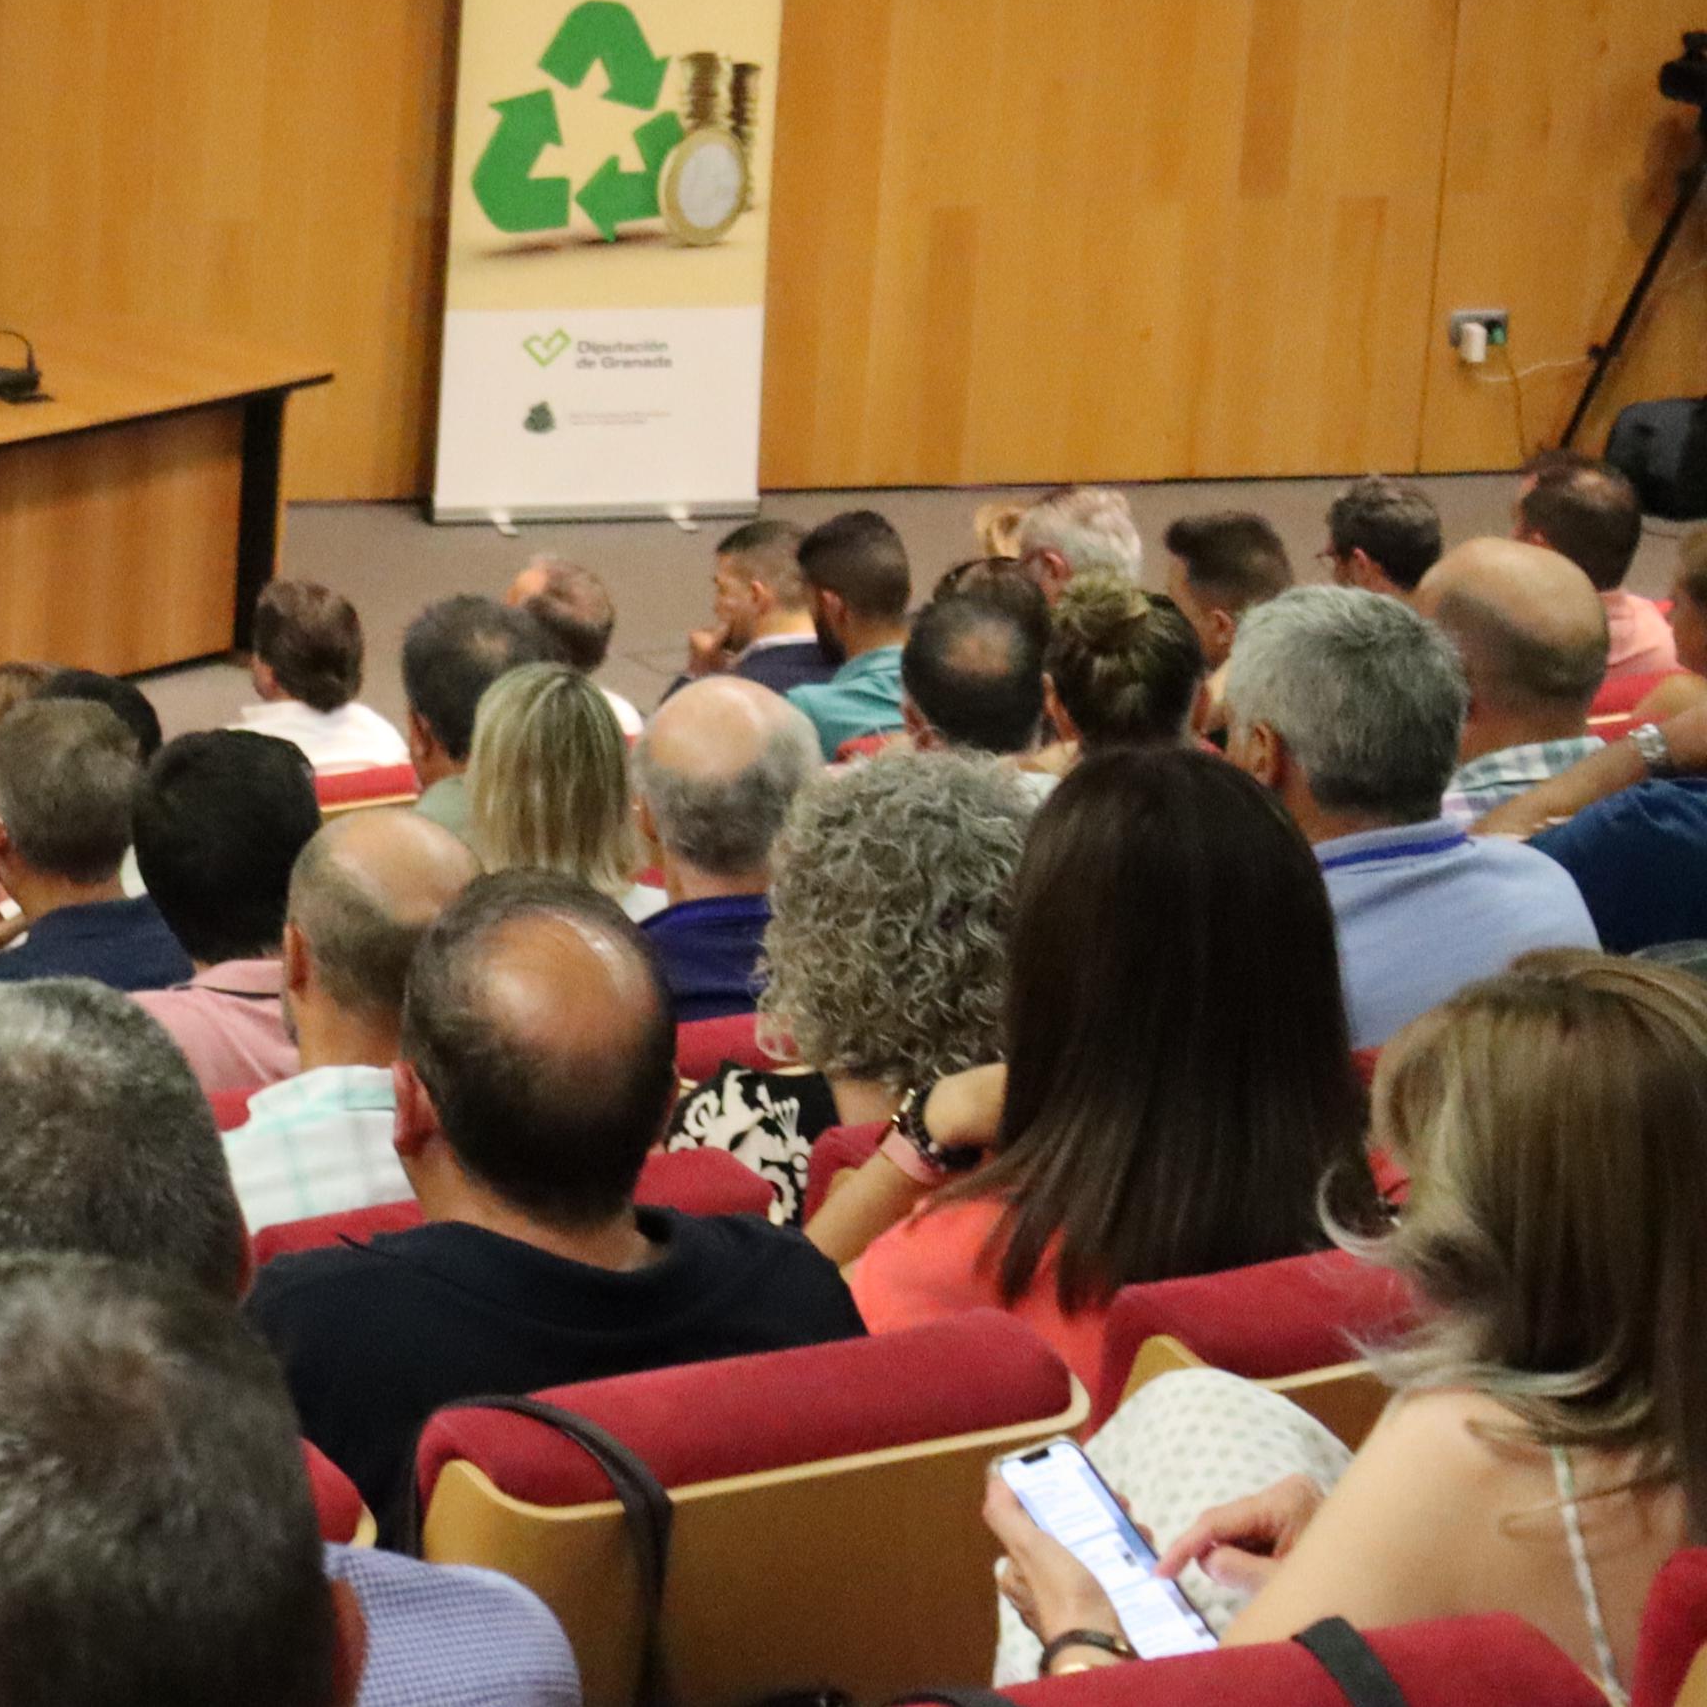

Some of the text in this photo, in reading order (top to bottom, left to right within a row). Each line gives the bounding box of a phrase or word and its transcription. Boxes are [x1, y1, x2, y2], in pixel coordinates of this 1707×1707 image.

[577, 340, 668, 355] Diputación
[576, 356, 672, 369] de Granada
